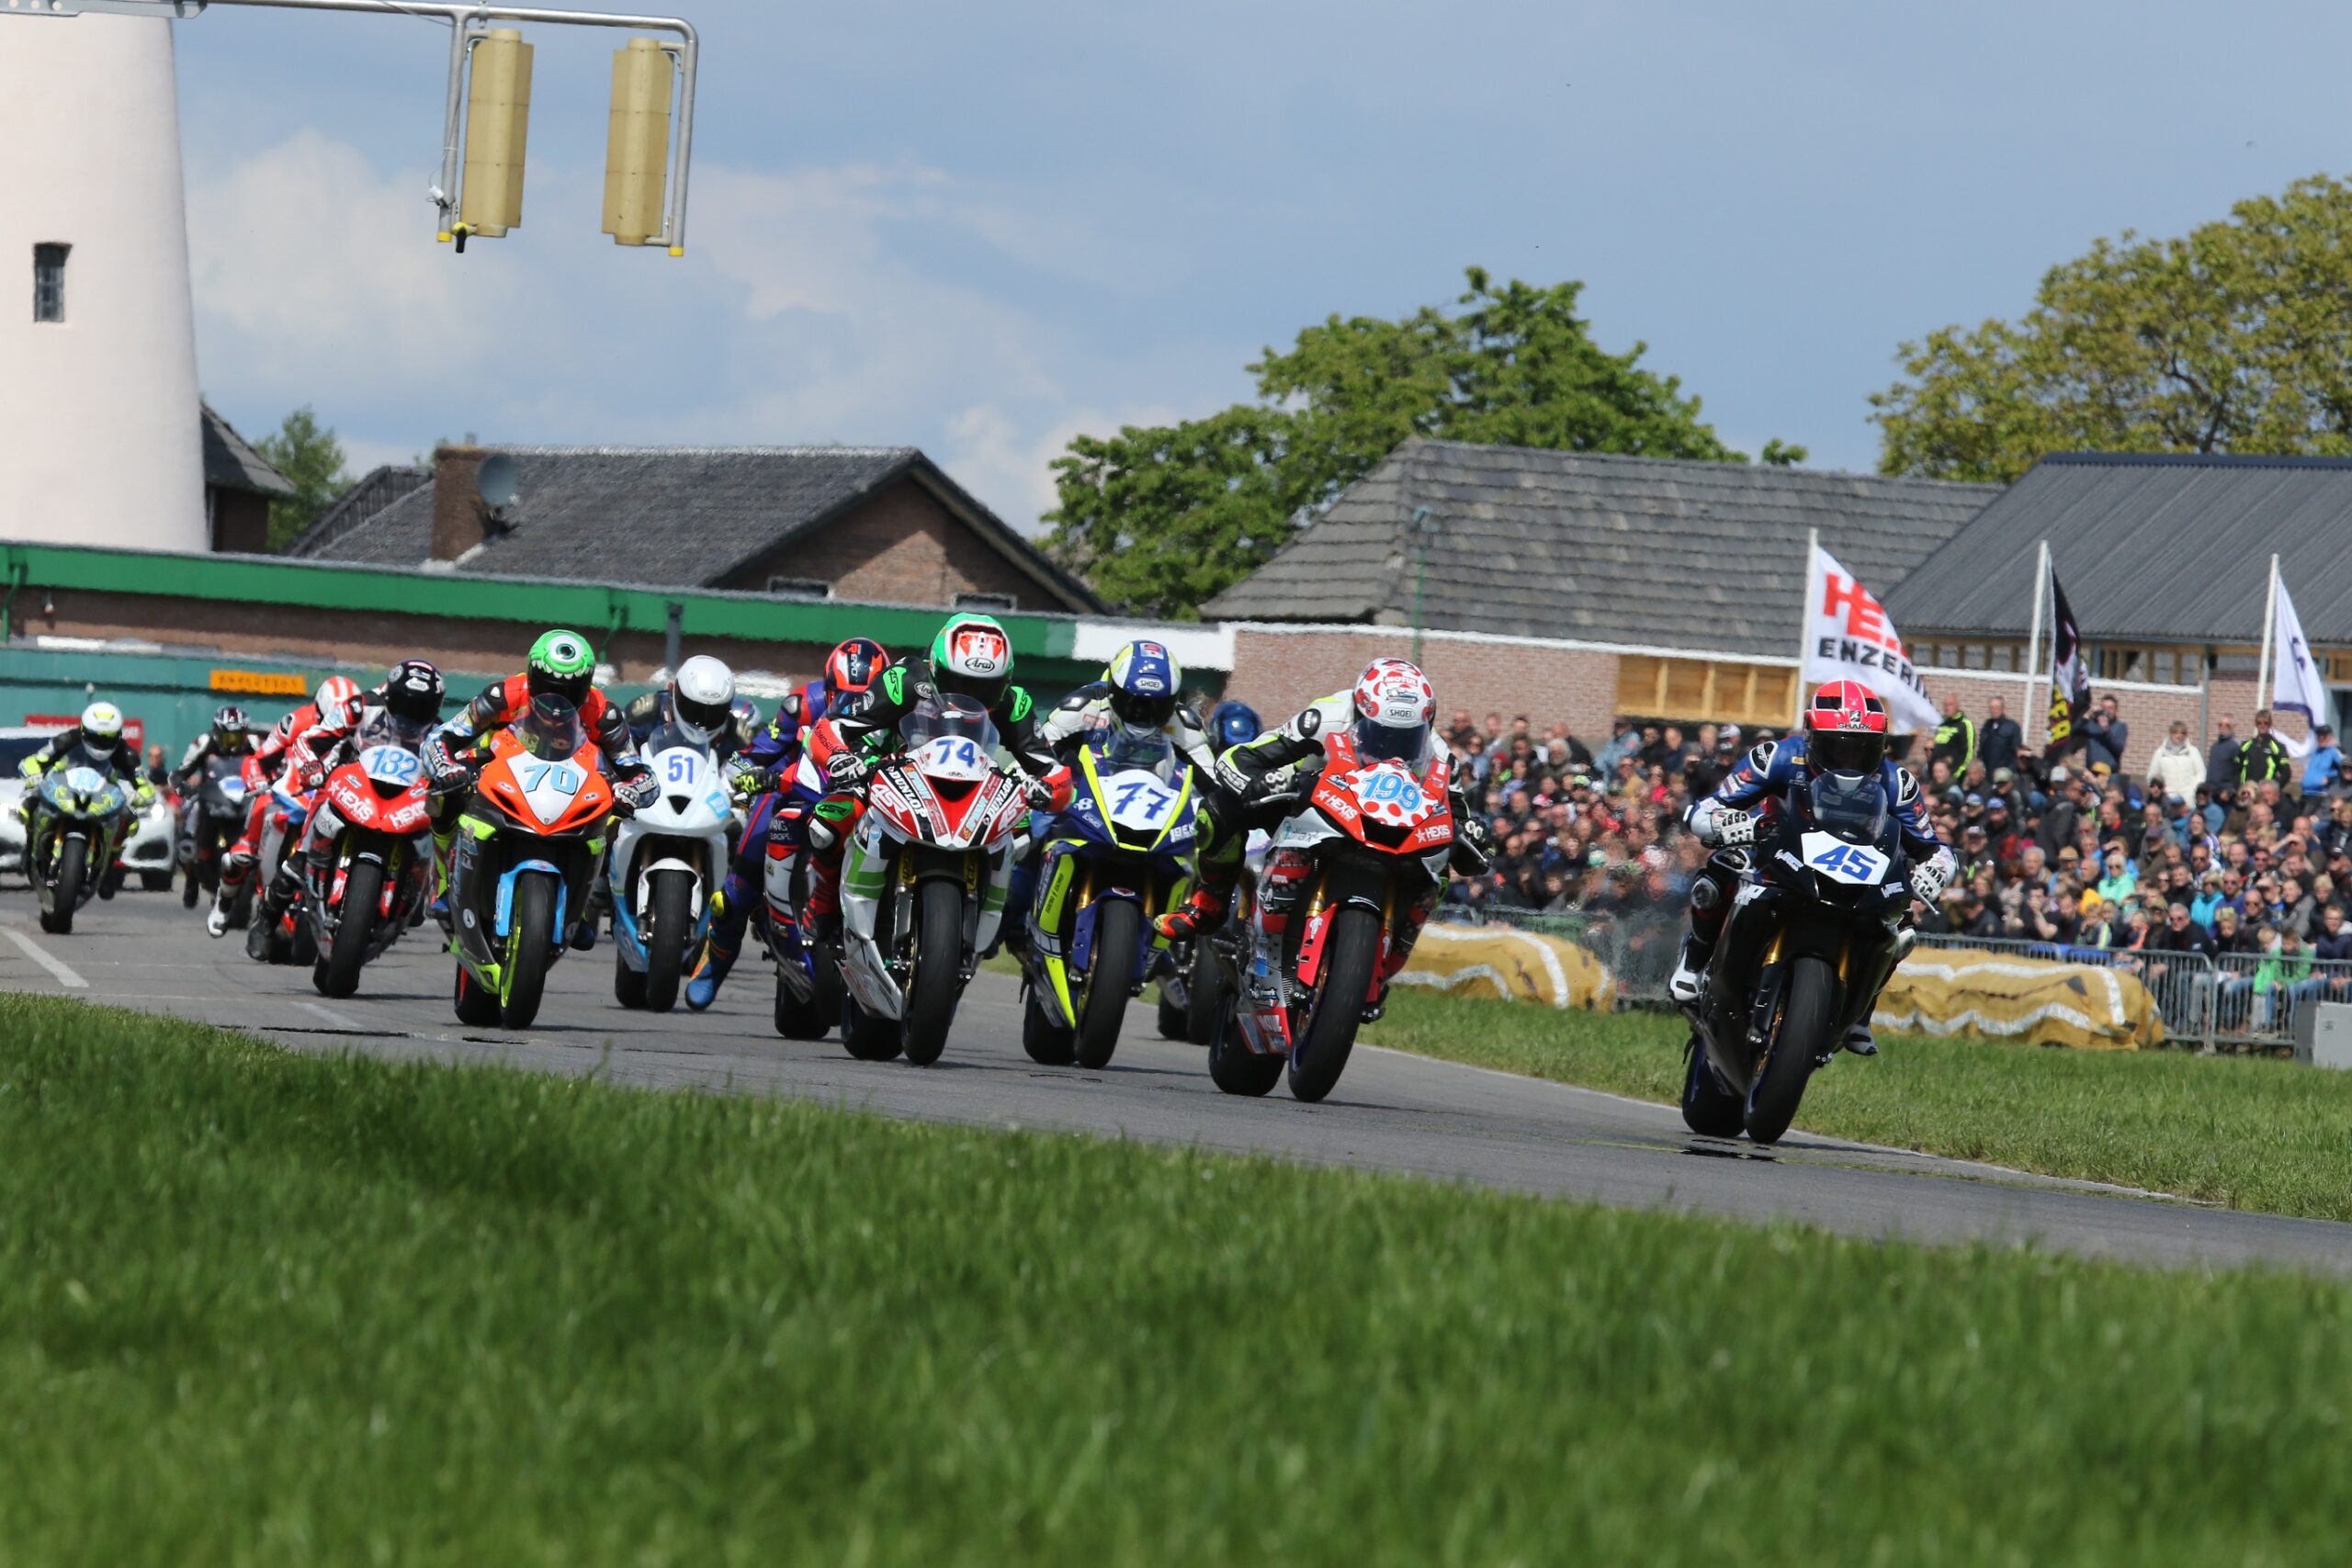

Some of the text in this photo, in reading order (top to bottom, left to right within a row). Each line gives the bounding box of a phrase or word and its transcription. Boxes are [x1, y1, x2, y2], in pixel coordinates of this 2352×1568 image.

[967, 658, 993, 671] Arai
[1139, 679, 1160, 688] SHOEI
[1389, 708, 1413, 717] SHOEI
[1838, 722, 1872, 730] SHARK
[372, 748, 418, 784] 182
[668, 754, 694, 784] 51
[935, 739, 975, 768] 74
[524, 763, 579, 795] 70
[889, 770, 928, 818] DUNLOP
[1362, 772, 1421, 811] 199
[337, 786, 374, 822] HEXIS
[818, 804, 847, 816] 4SR
[871, 784, 909, 819] 4SR
[988, 777, 1014, 818] DUNLOP
[1113, 782, 1171, 820] 77
[1329, 794, 1359, 821] HEXIS
[1425, 825, 1451, 840] HEXIS
[1812, 845, 1878, 881] 45
